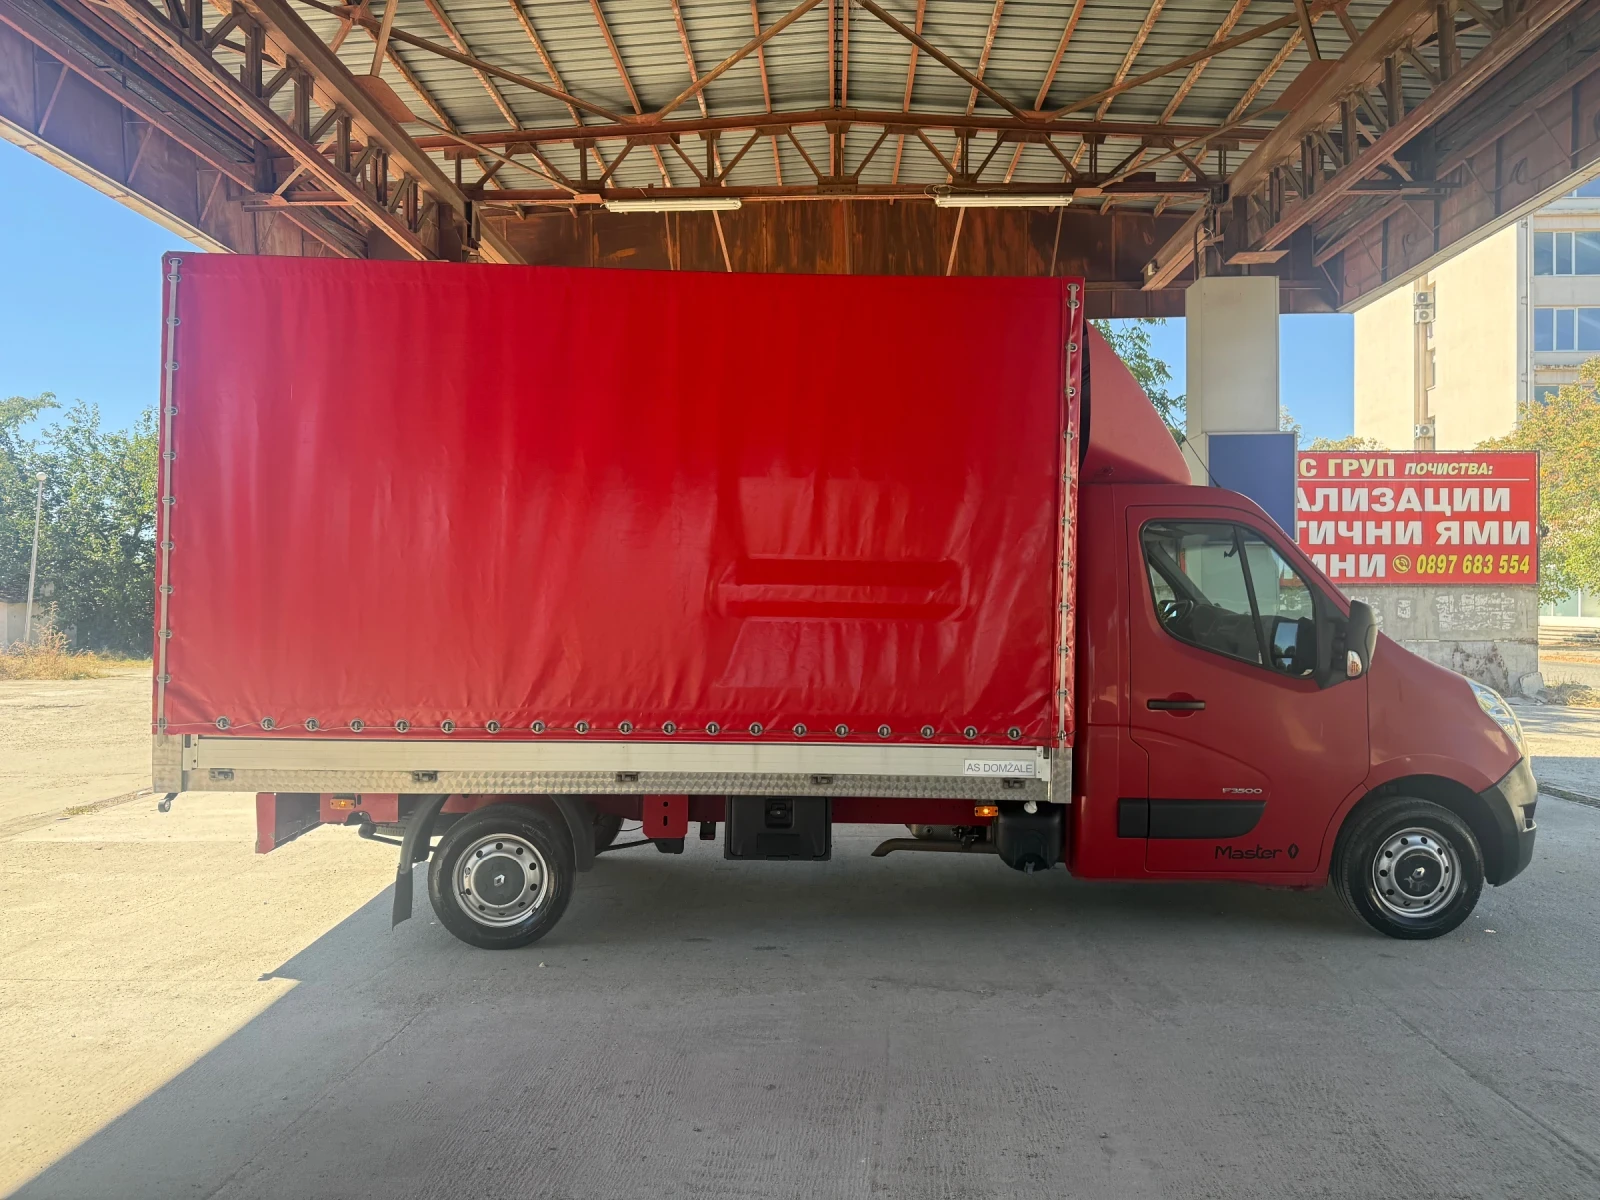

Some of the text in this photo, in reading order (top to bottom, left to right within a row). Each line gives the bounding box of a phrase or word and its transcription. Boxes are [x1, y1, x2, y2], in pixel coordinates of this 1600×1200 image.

[1297, 458, 1493, 477] С ГРУП ПОЧИСТВА:
[1435, 520, 1530, 545] ЯМИ
[1416, 554, 1457, 574] 0897
[1462, 554, 1493, 574] 683
[1498, 554, 1530, 574] 554
[966, 762, 1033, 773] AS DOMŽALE
[1214, 844, 1283, 860] Master
